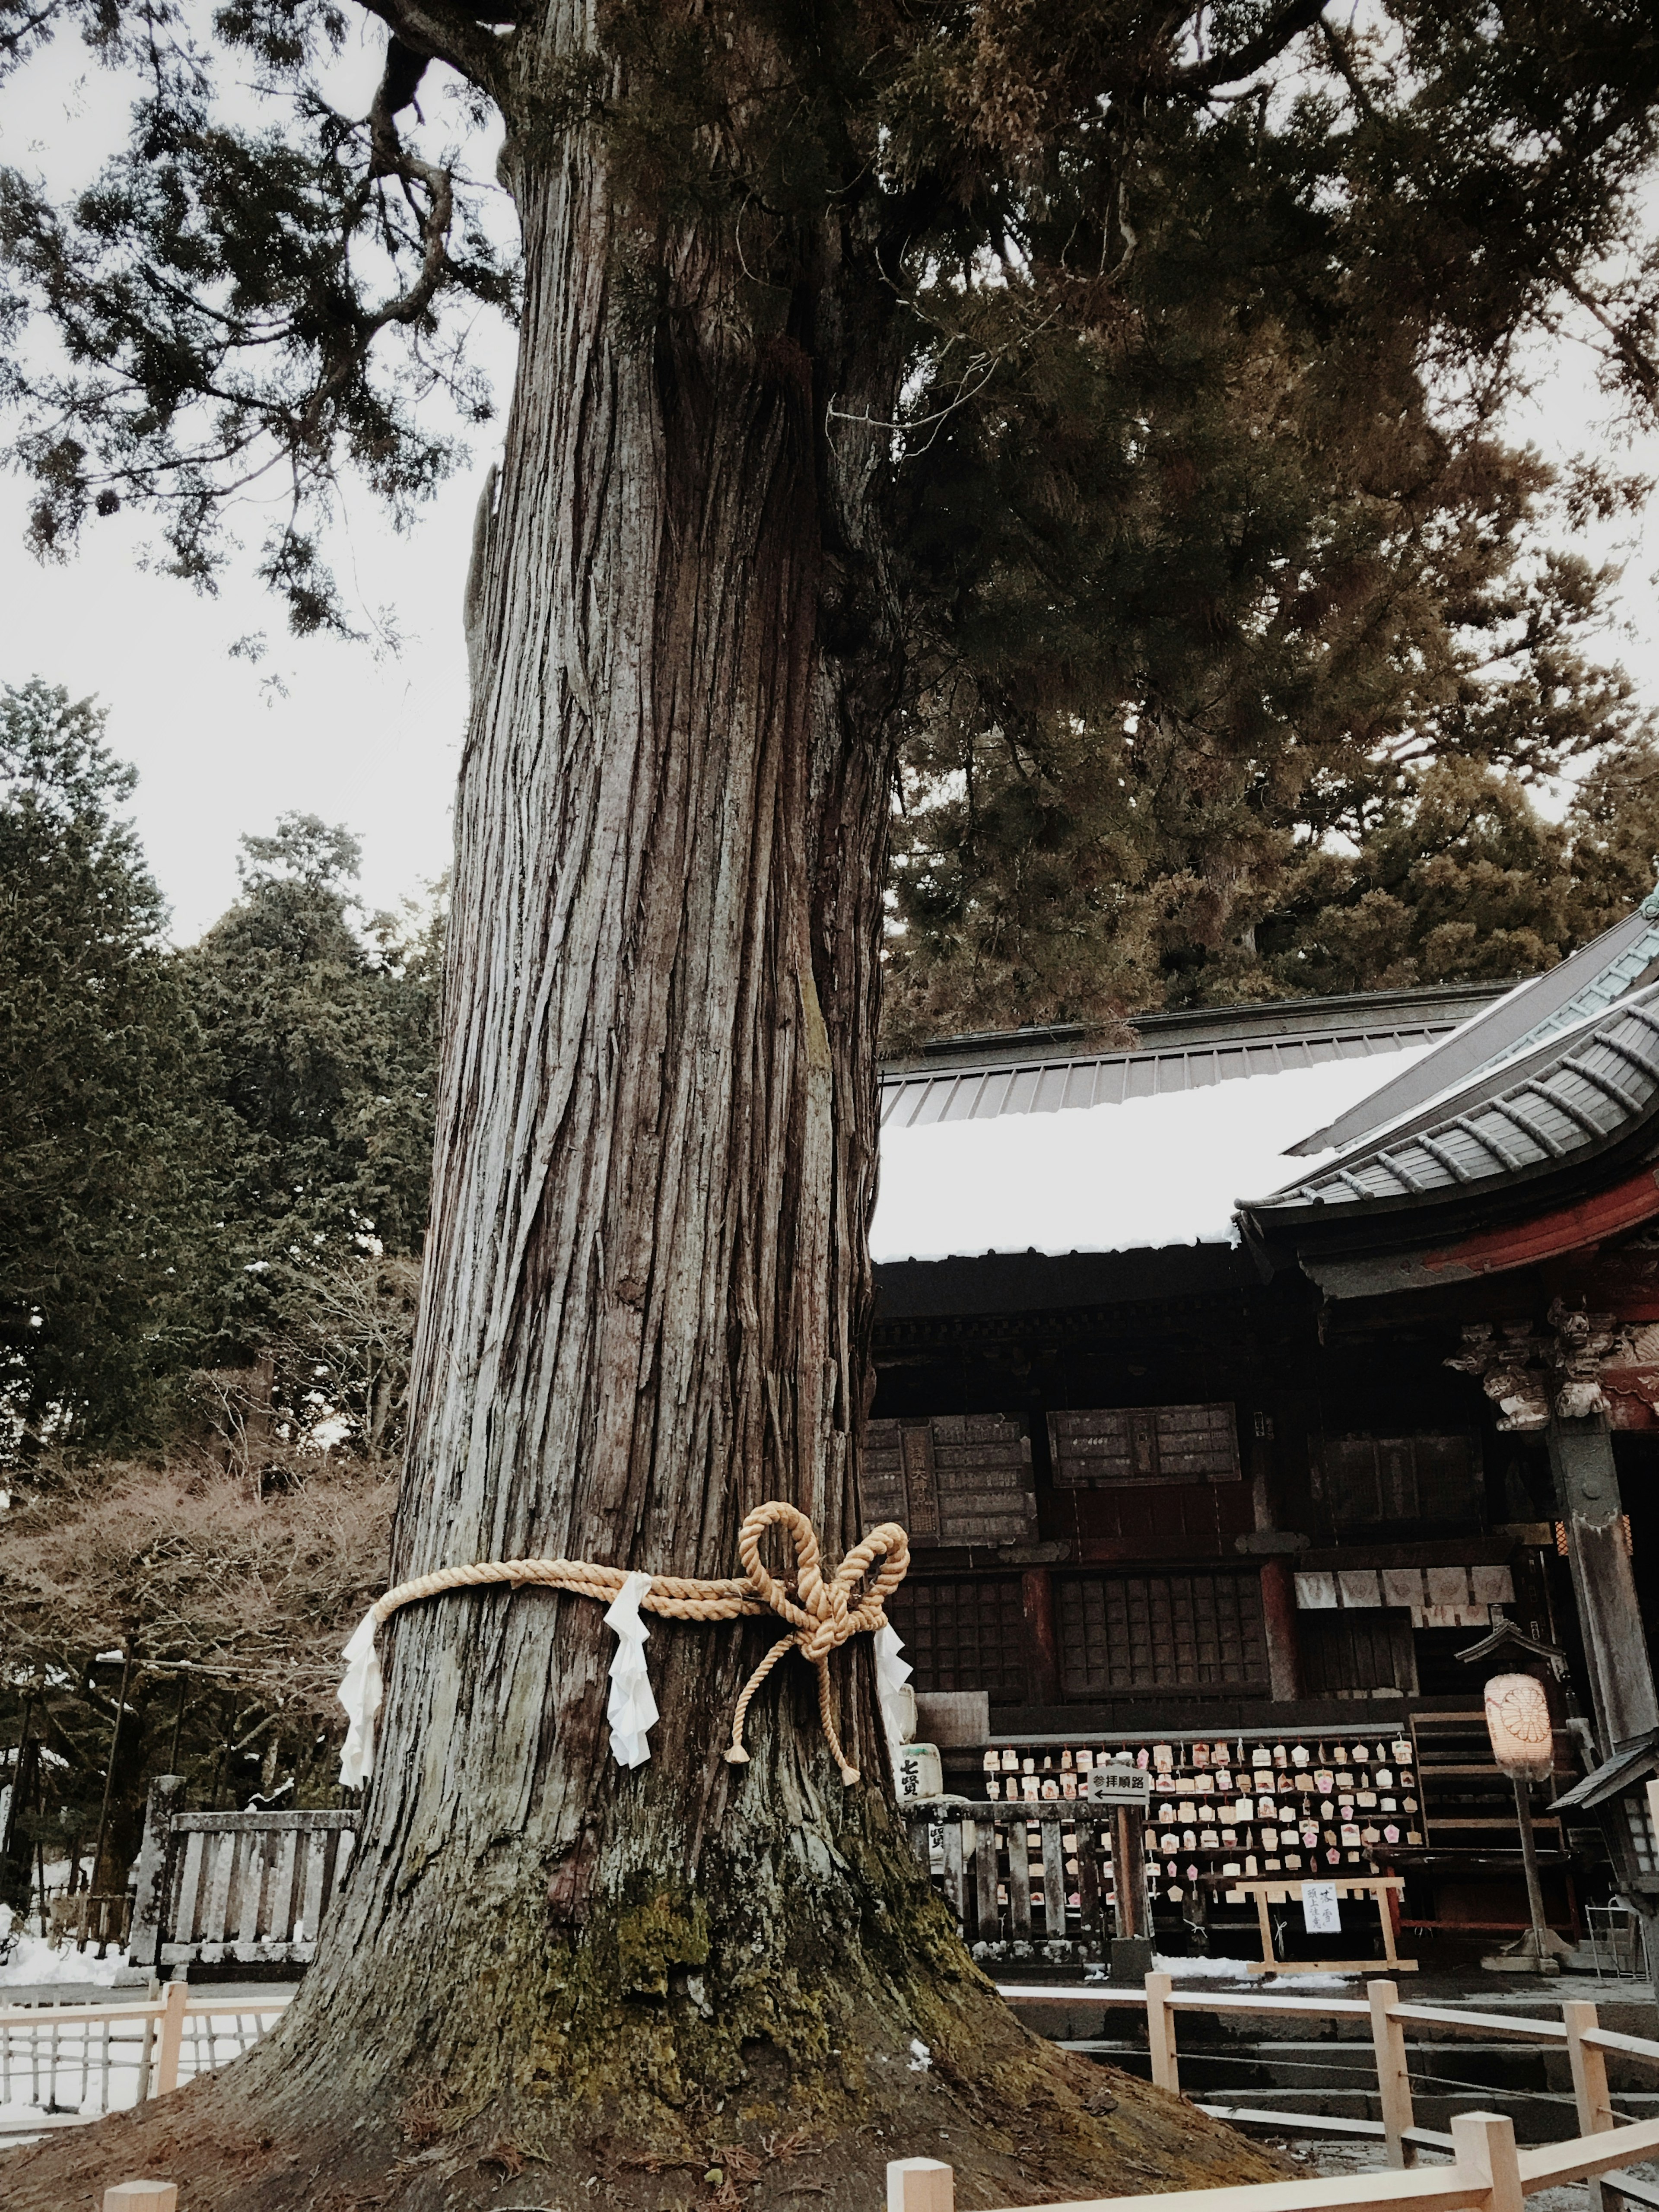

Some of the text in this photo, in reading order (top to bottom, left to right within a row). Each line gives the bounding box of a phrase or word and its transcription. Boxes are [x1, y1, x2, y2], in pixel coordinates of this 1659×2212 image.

[900, 1760, 919, 1796] 七賢
[1093, 1775, 1144, 1788] 参拝順路
[931, 1821, 944, 1849] 賢
[1307, 1888, 1321, 1929] 頭上注意
